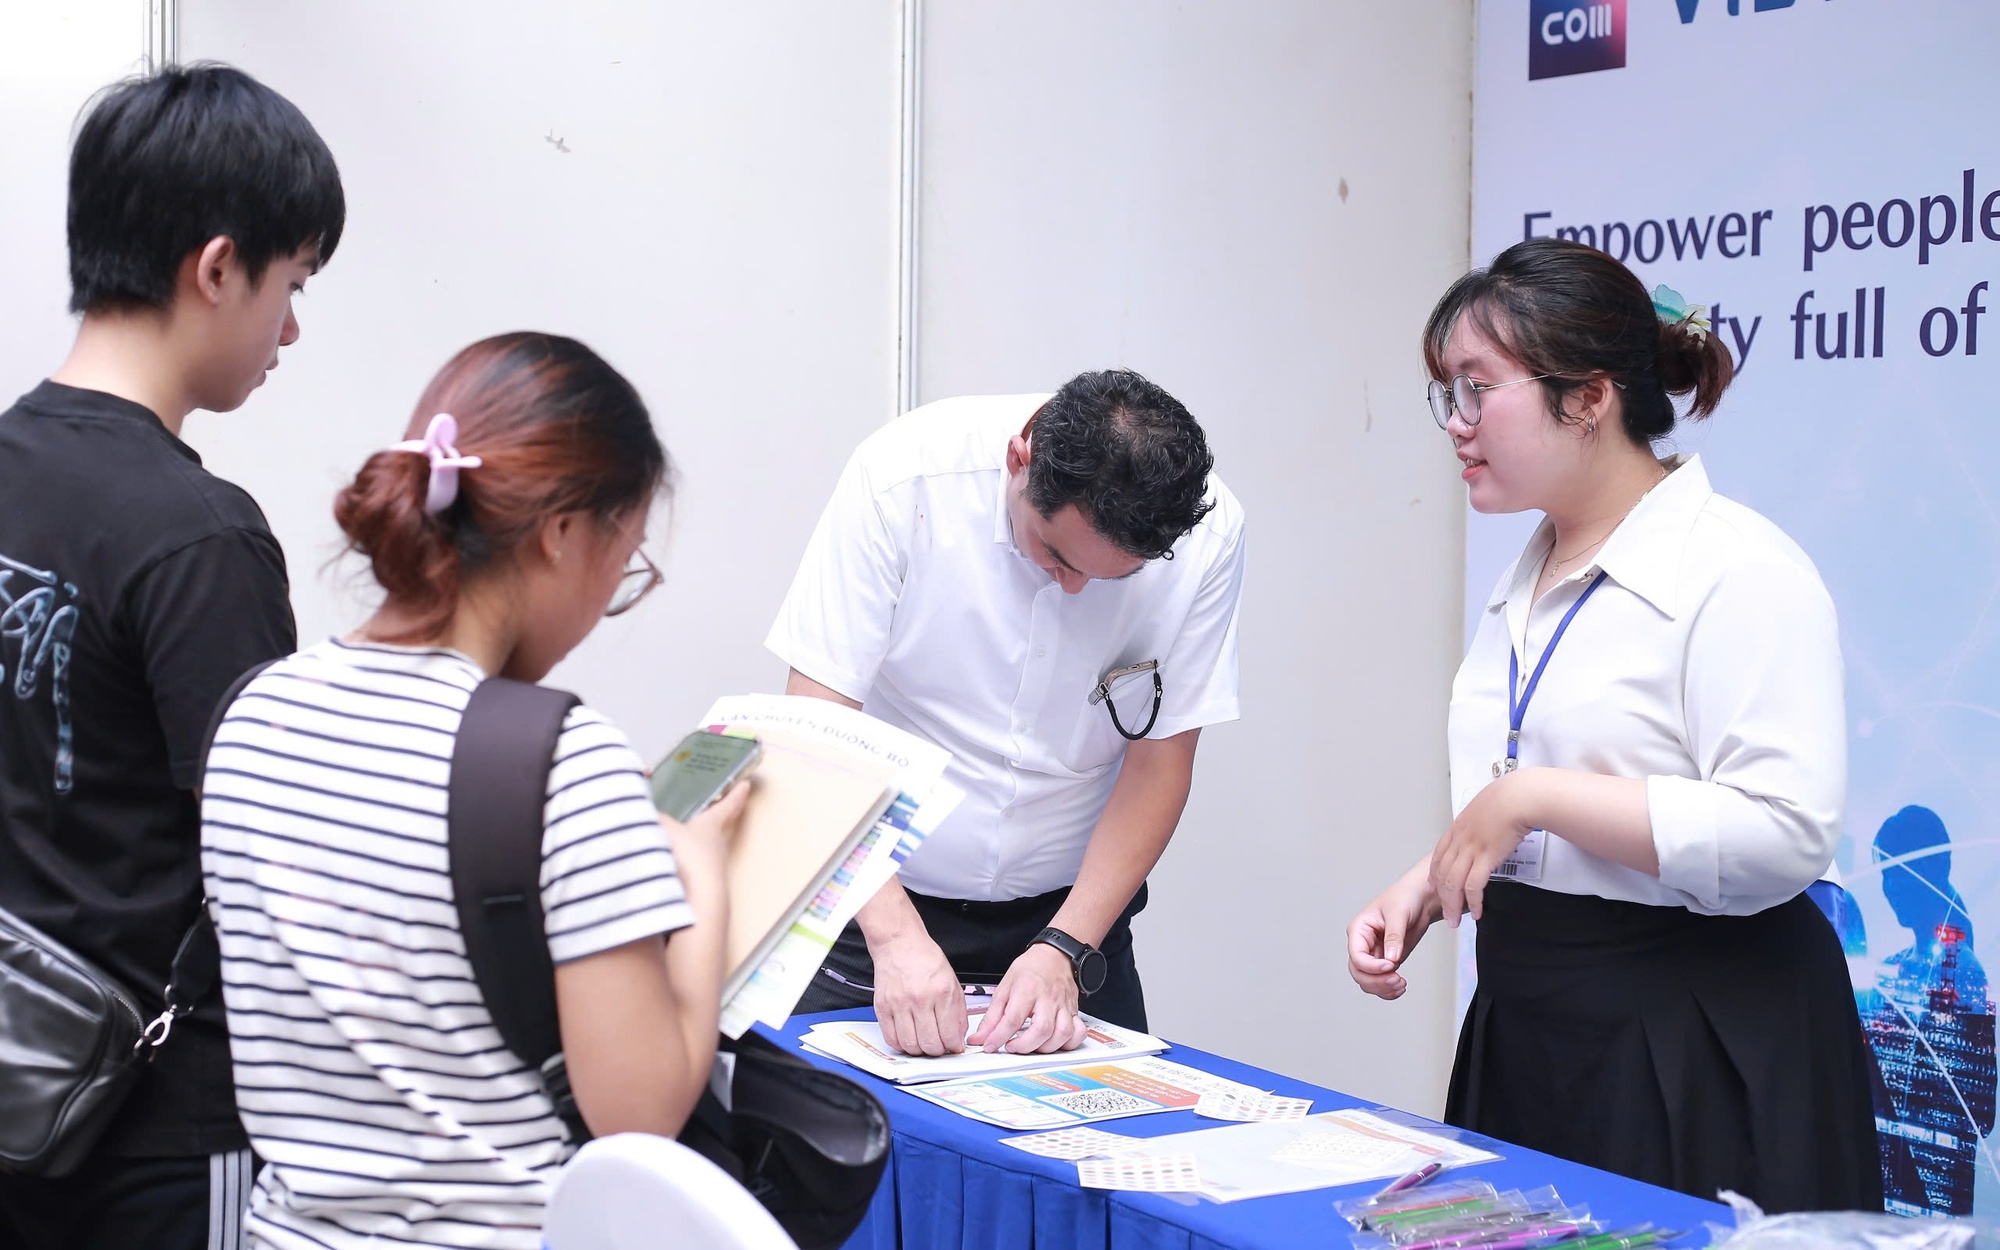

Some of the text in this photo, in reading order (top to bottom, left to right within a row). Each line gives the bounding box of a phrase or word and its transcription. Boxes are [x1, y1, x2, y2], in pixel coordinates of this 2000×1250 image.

[1803, 168, 2000, 272] people
[1706, 281, 1989, 379] ty full of
